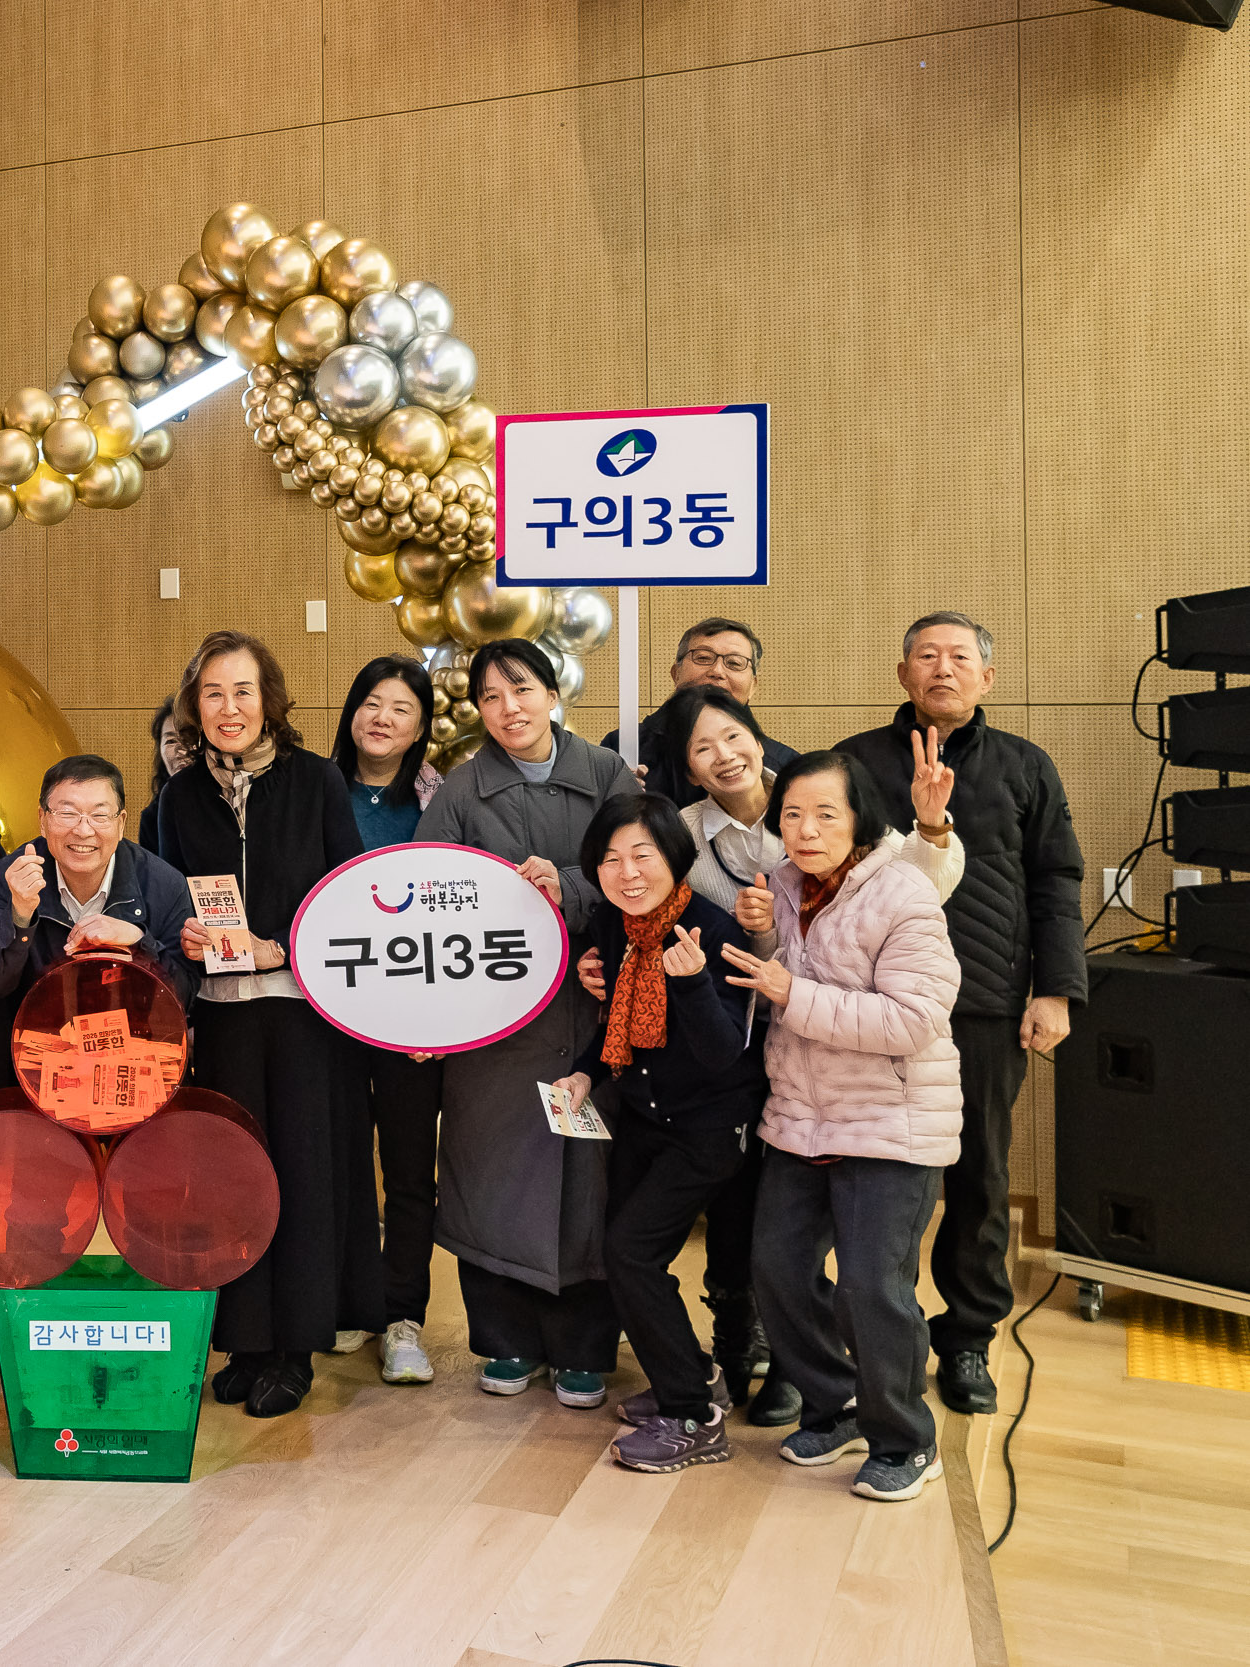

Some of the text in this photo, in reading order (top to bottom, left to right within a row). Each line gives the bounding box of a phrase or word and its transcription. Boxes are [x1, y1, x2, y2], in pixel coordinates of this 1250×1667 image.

[526, 493, 735, 549] 구의3동
[419, 879, 478, 893] 소통하며 발전하는
[198, 896, 236, 907] 따뜻한
[420, 891, 479, 912] 행복광진
[324, 929, 533, 988] 구의3동
[83, 1036, 124, 1052] 따뜻한
[116, 1065, 129, 1107] 따뜻한
[34, 1324, 165, 1346] 감사합니다!
